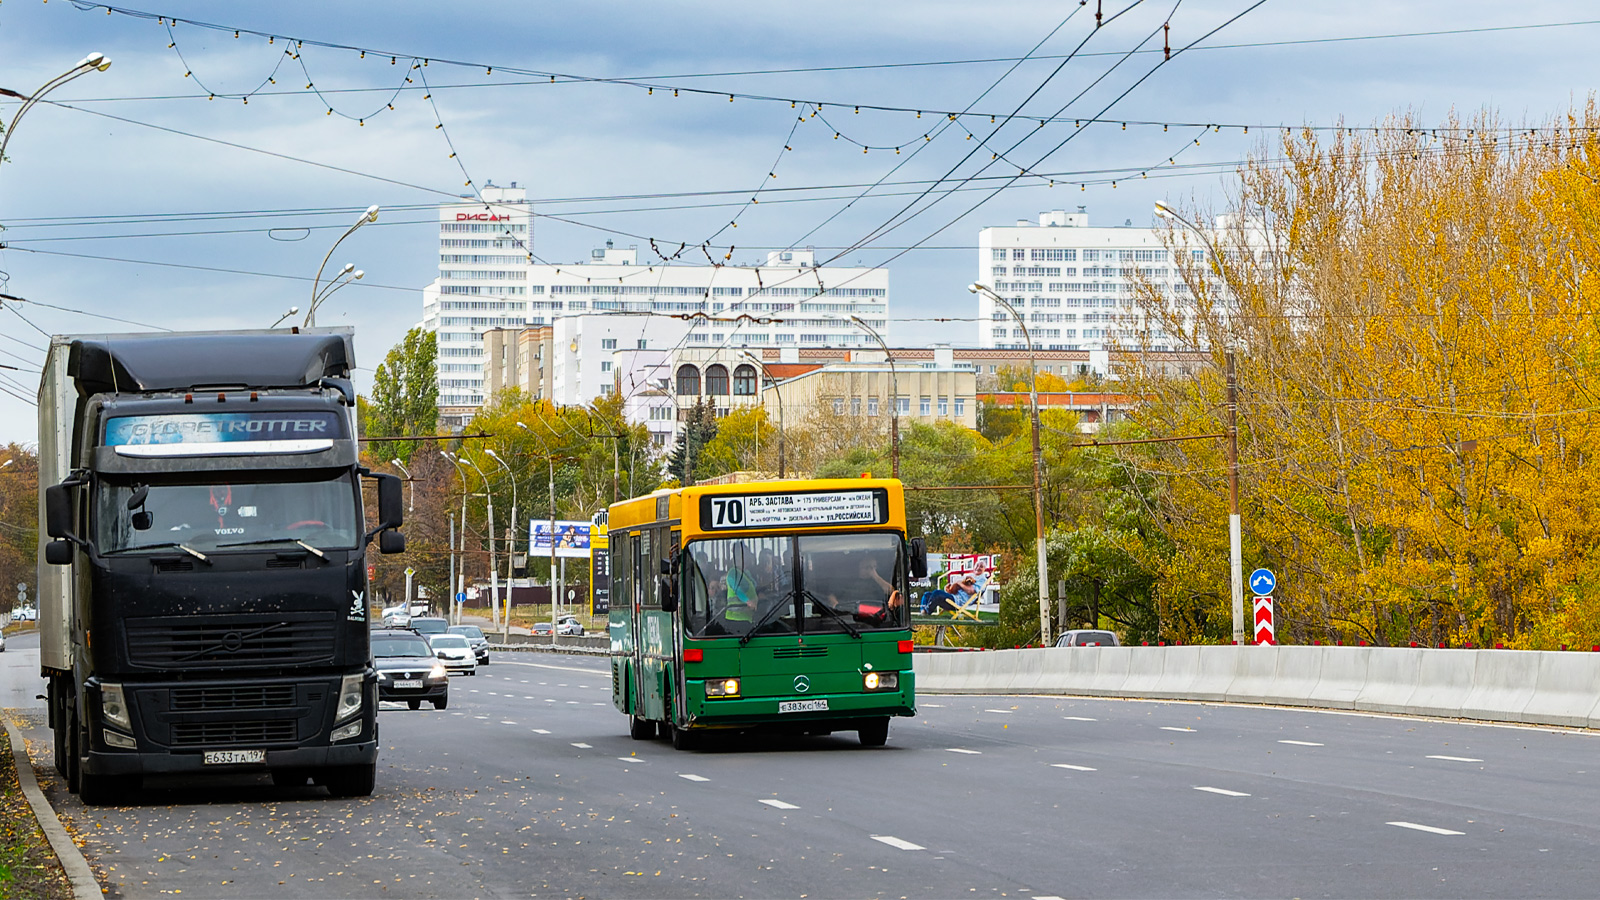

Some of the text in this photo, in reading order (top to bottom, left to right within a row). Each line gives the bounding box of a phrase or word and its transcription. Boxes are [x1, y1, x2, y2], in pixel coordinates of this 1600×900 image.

[456, 213, 510, 221] РИСАН
[749, 497, 764, 506] АРБ.
[765, 496, 794, 506] ЗАСТАВА
[813, 495, 842, 503] УНИВЕРСАМ
[713, 499, 743, 525] 70
[206, 751, 263, 763] Е633ТА 197
